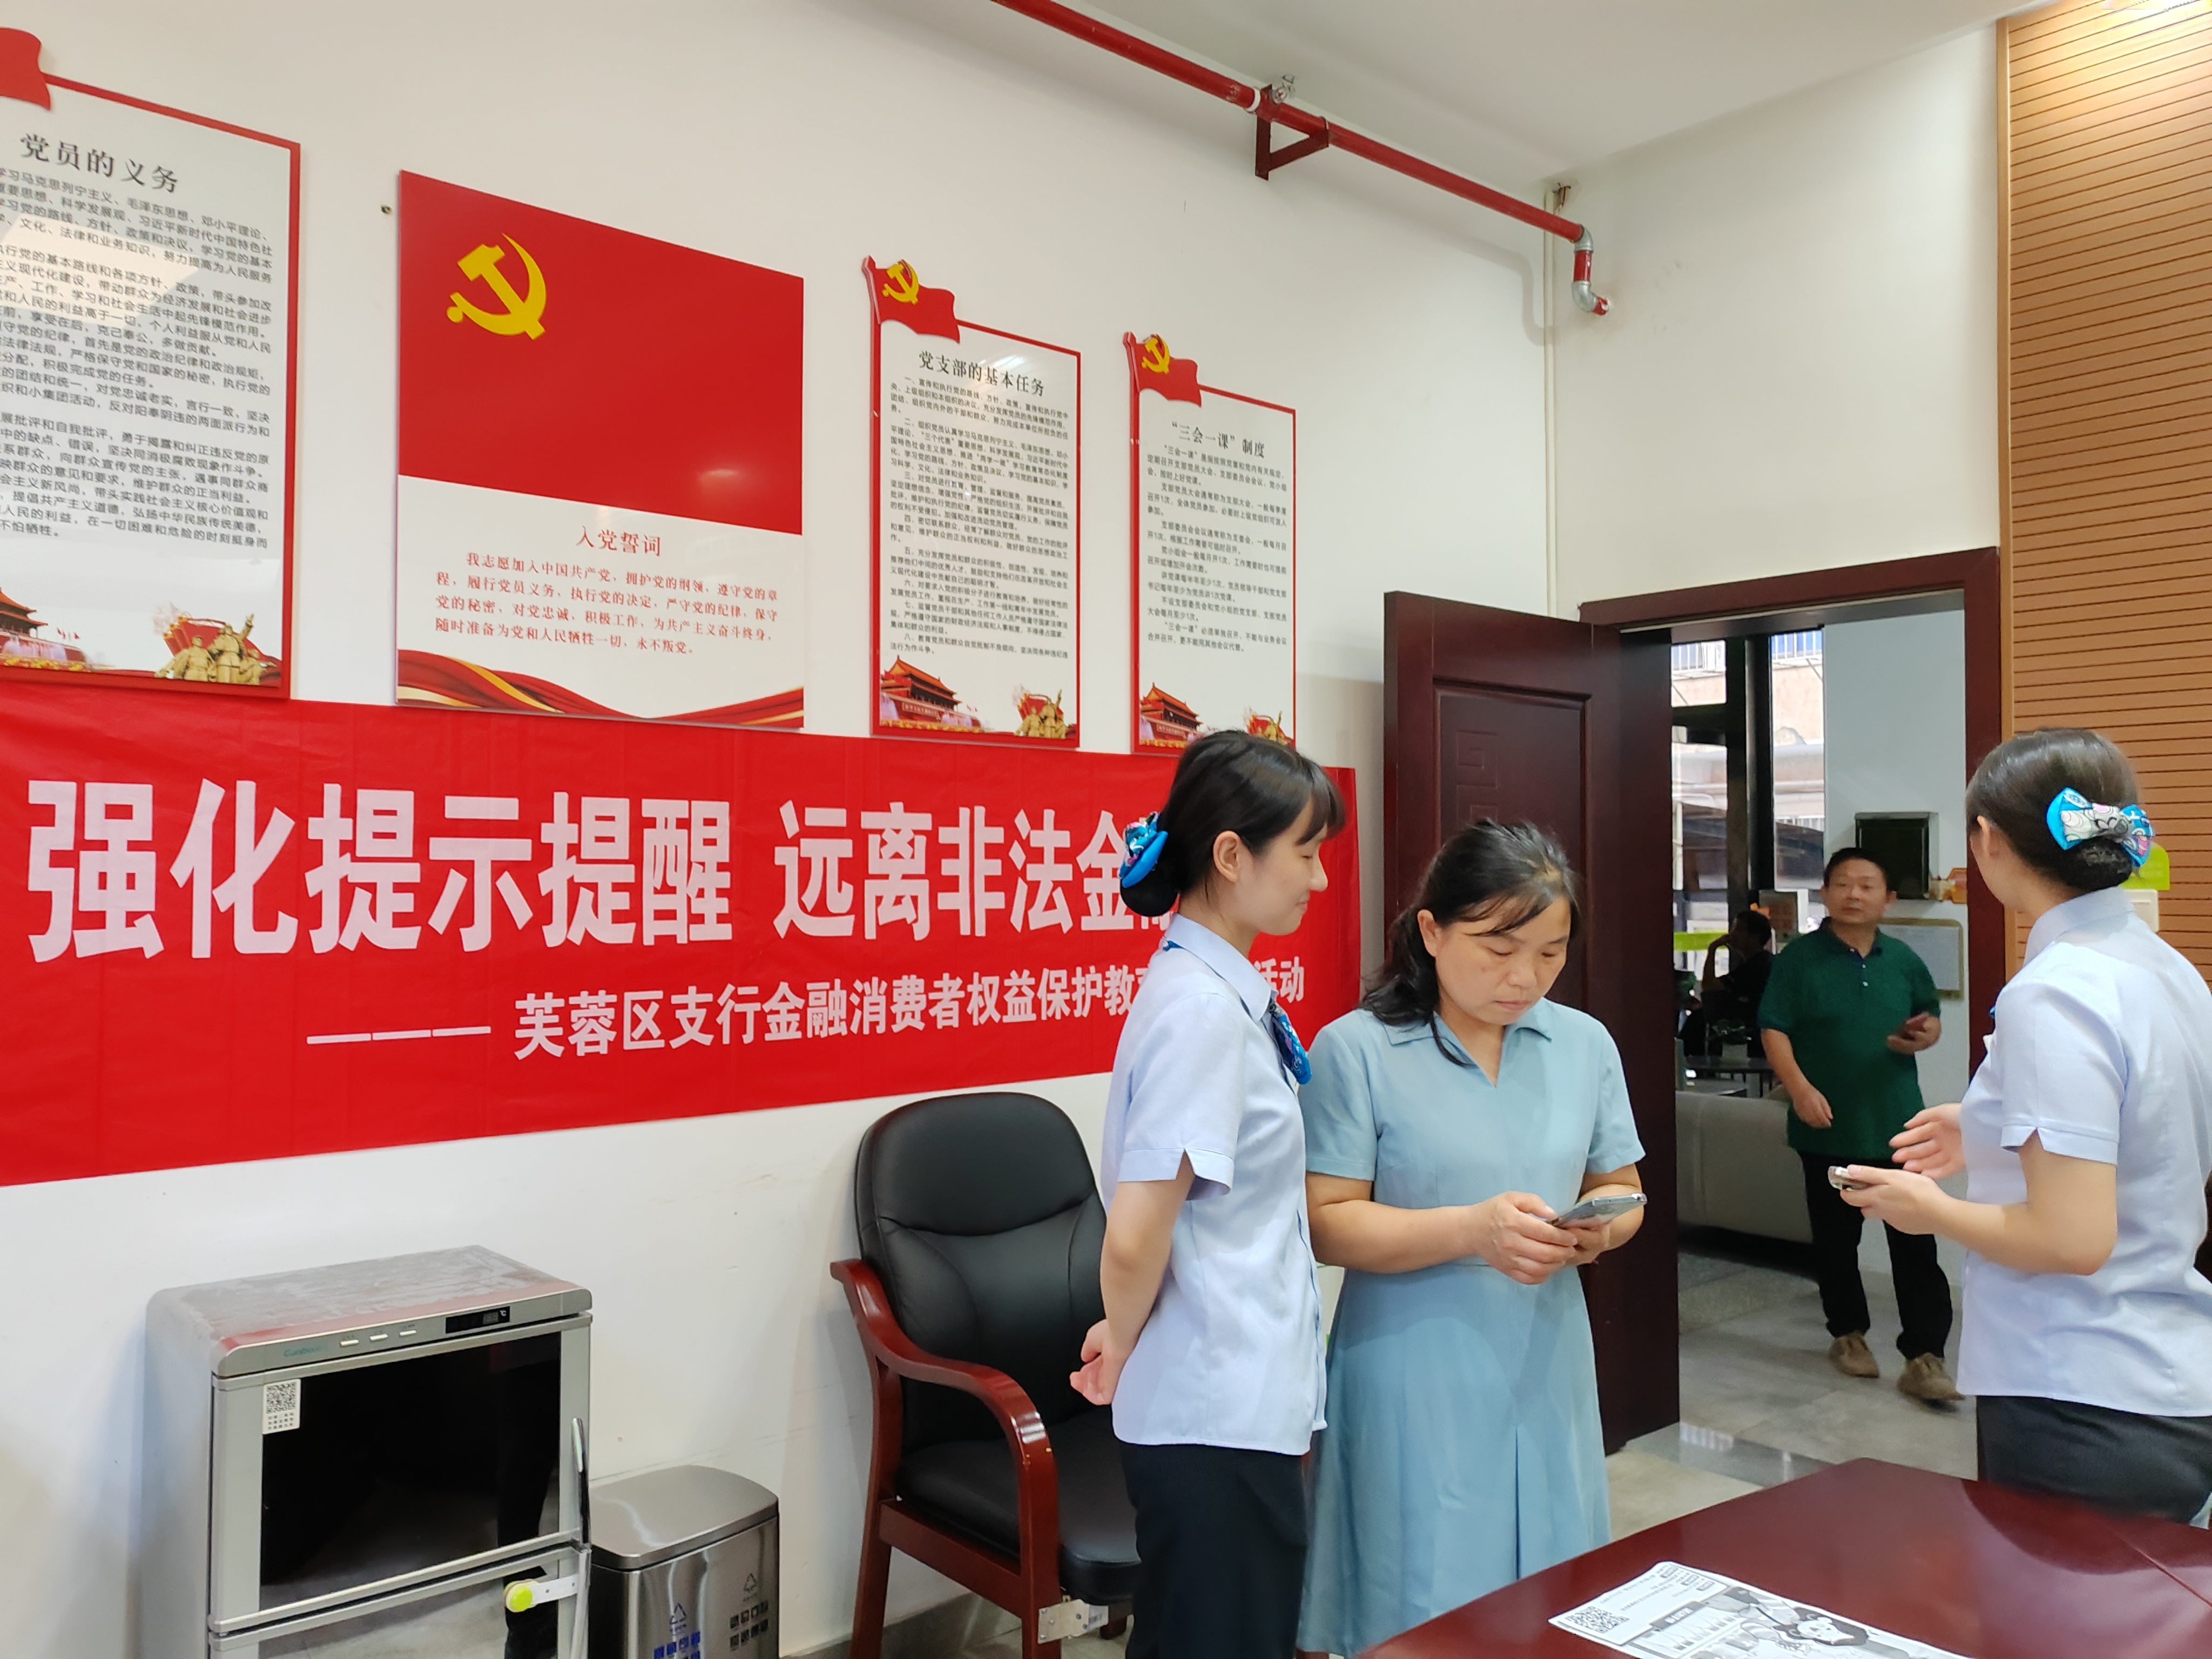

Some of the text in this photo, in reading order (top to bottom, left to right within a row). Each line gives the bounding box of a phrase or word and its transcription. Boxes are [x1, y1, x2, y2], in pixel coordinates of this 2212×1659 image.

[20, 133, 178, 193] 党员的义务
[919, 350, 1044, 397] 党支部的基本任务
[576, 525, 661, 557] 入党誓词
[28, 778, 732, 962] 强化提示提醒
[773, 800, 1170, 941] 远离非法金
[514, 964, 1148, 1060] 芙蓉区支行金融消费者权益保护教
